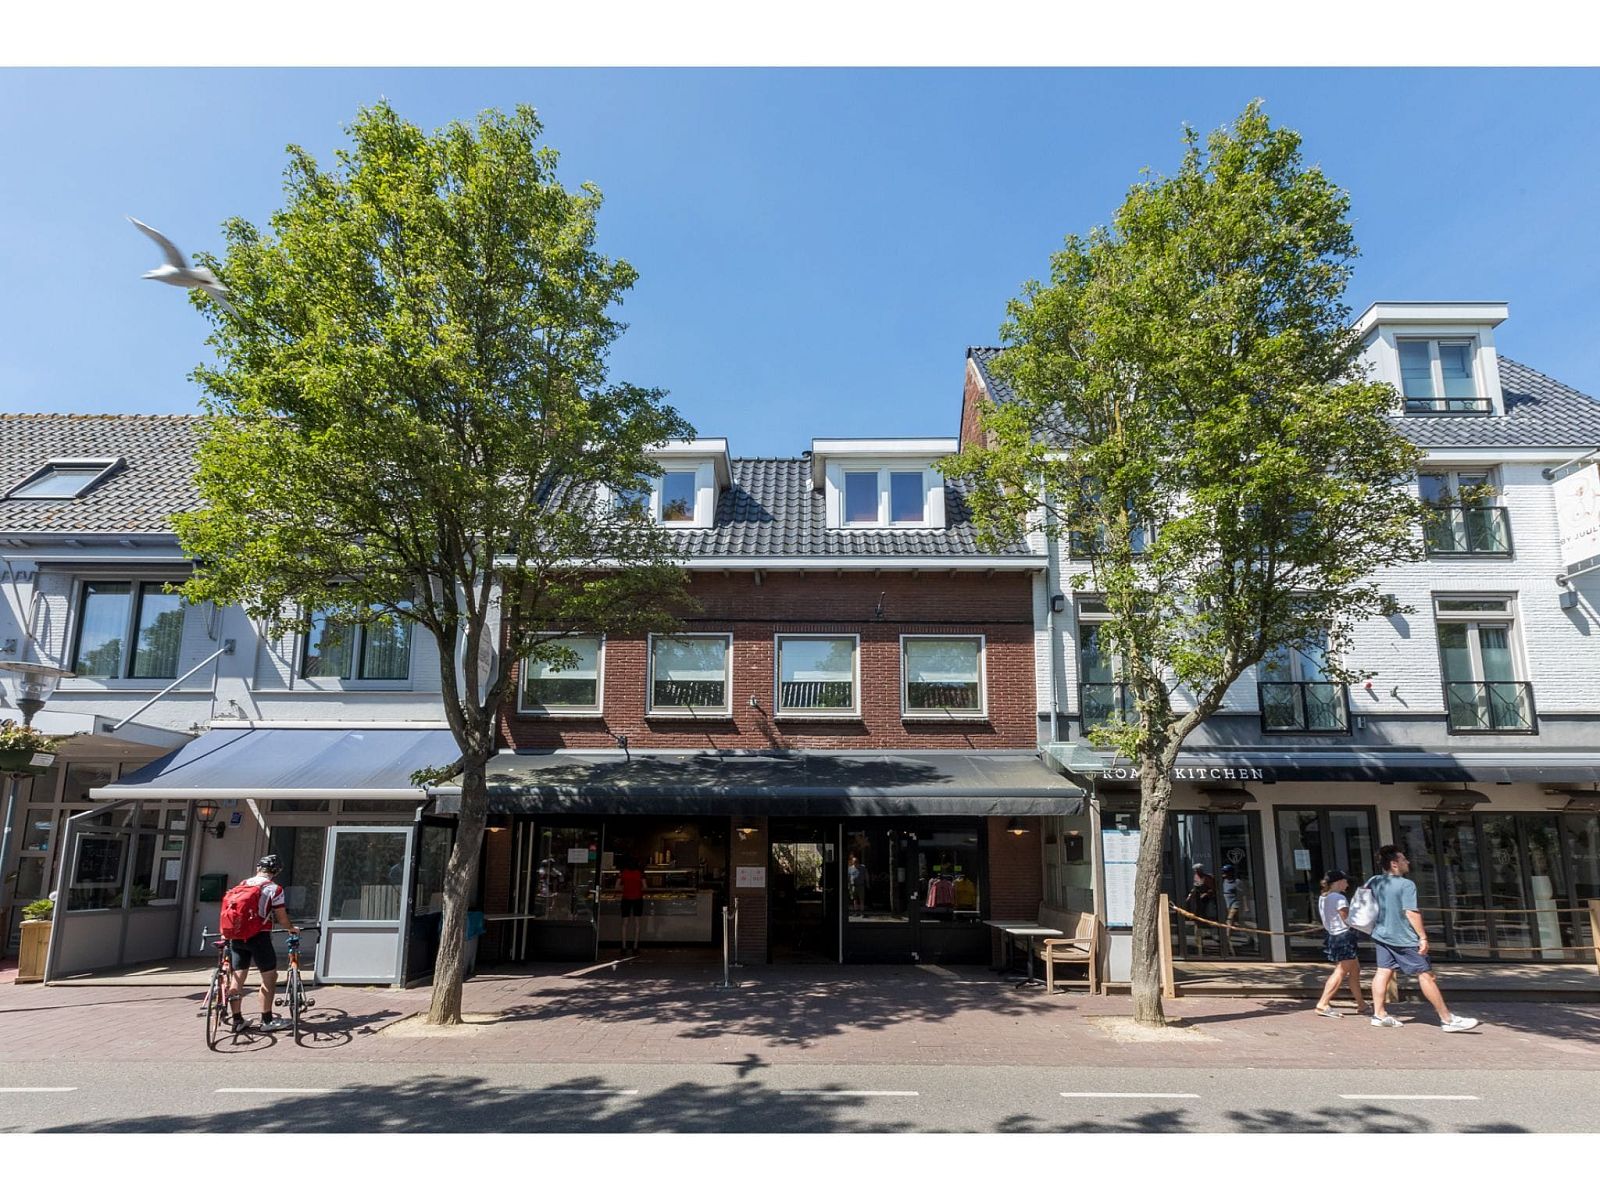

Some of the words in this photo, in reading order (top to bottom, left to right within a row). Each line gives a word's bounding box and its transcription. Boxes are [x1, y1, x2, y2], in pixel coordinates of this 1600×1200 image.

[1560, 536, 1571, 546] BY
[1574, 524, 1600, 540] JUUL
[1103, 767, 1140, 779] ROA
[1174, 768, 1264, 779] KITCHEN
